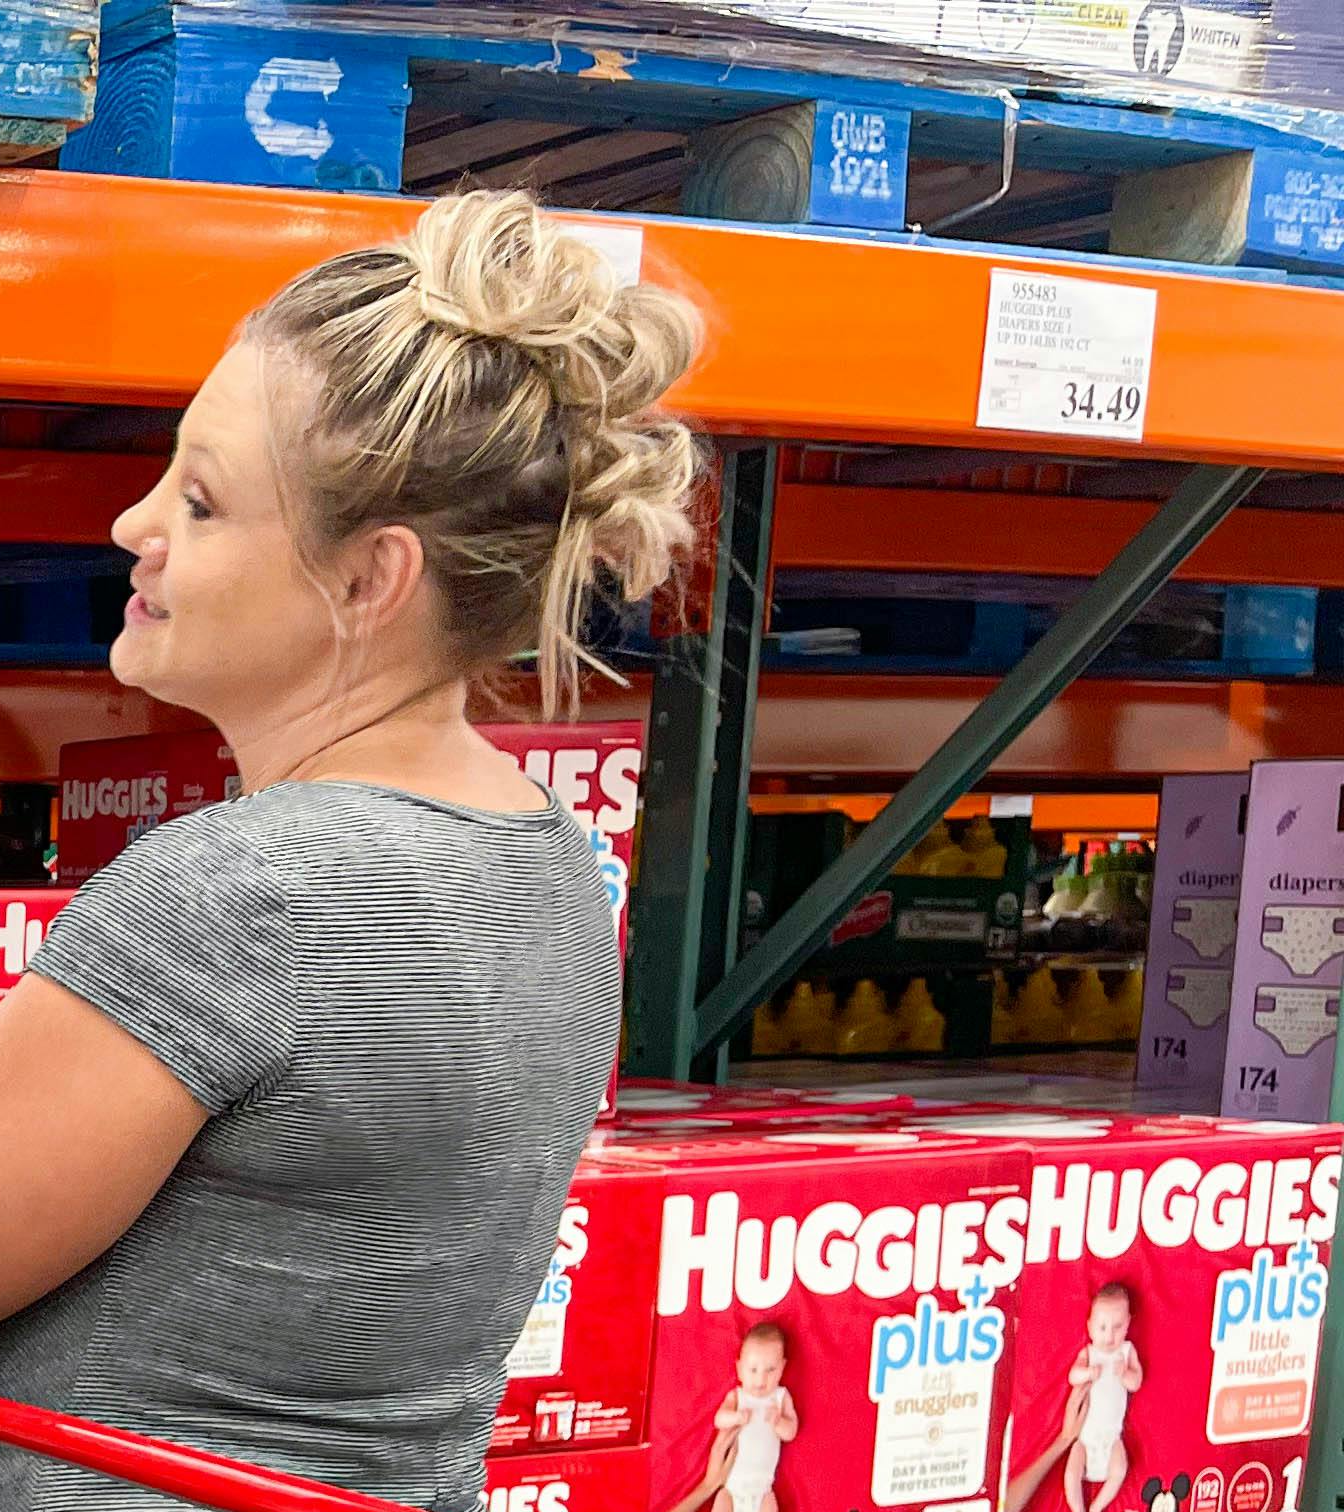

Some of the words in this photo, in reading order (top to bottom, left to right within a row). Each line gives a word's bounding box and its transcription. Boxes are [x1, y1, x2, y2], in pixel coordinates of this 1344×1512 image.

[245, 57, 344, 160] C
[1012, 282, 1057, 301] 955483
[999, 301, 1044, 316] HUGGIES
[1046, 305, 1072, 319] PLUS
[998, 316, 1040, 331] DIAPERS
[1043, 320, 1064, 334] SIZE
[997, 331, 1012, 345] UP
[1012, 333, 1027, 346] TO
[1029, 334, 1057, 348] 14LBS
[1060, 336, 1075, 351] 192
[1076, 338, 1092, 351] CT
[1061, 382, 1141, 422] 34.49
[1239, 1066, 1278, 1093] 174
[1025, 1155, 1343, 1264] HUGGIES
[657, 1190, 1028, 1317] HUGGIES
